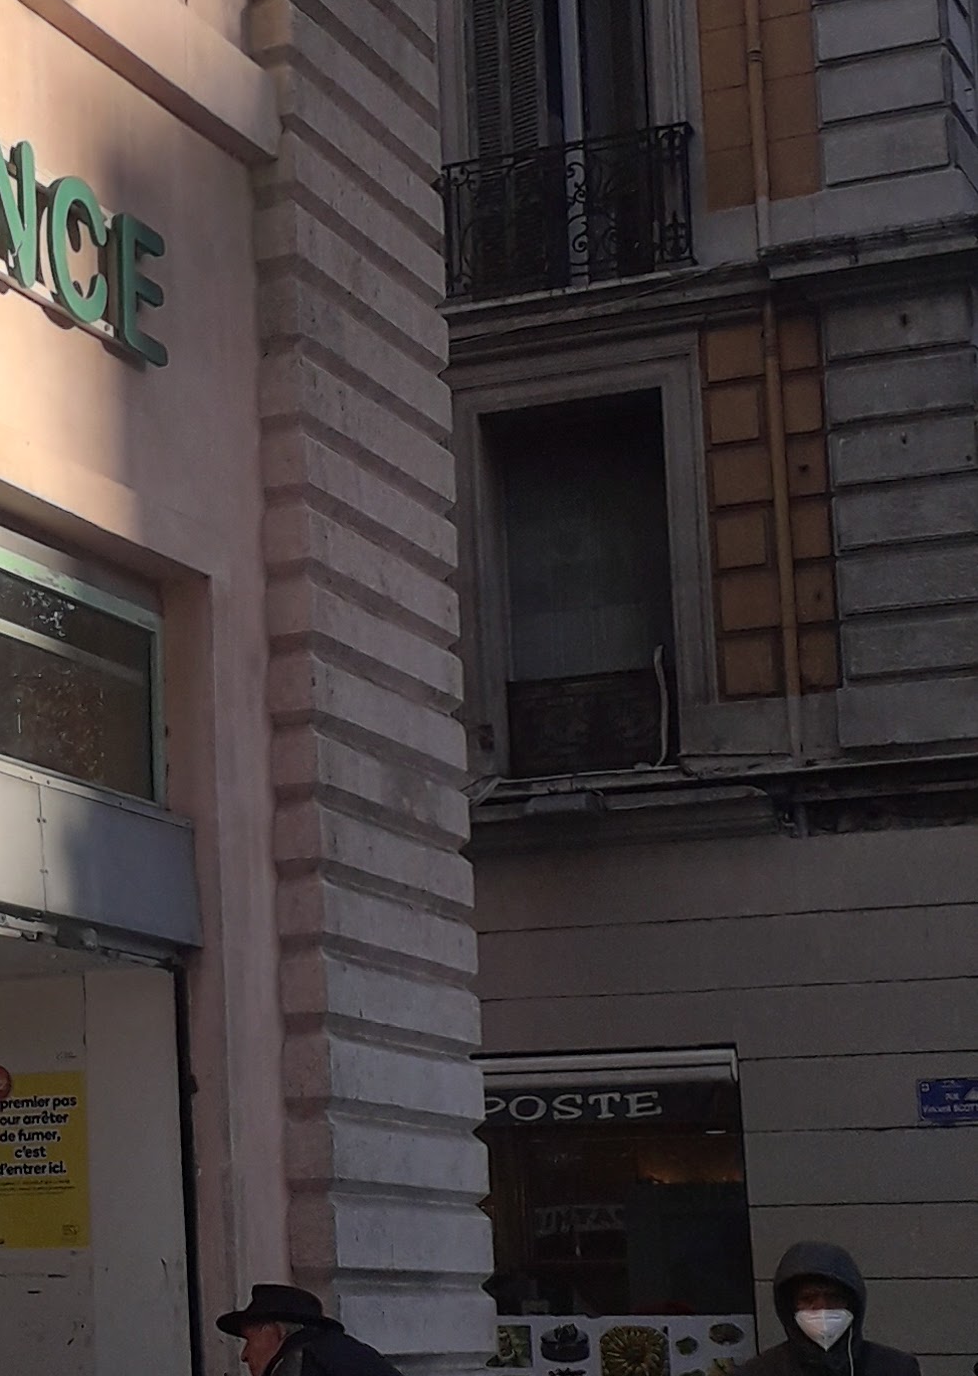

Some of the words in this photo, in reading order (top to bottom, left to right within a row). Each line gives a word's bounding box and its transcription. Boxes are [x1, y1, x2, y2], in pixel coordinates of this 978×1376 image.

[0, 1095, 50, 1112] premier
[53, 1096, 77, 1110] pas
[23, 1111, 69, 1124] arrêter
[0, 1130, 15, 1142] de
[18, 1129, 61, 1142] fumer,
[14, 1146, 47, 1158] c'est
[48, 1161, 67, 1173] ici.
